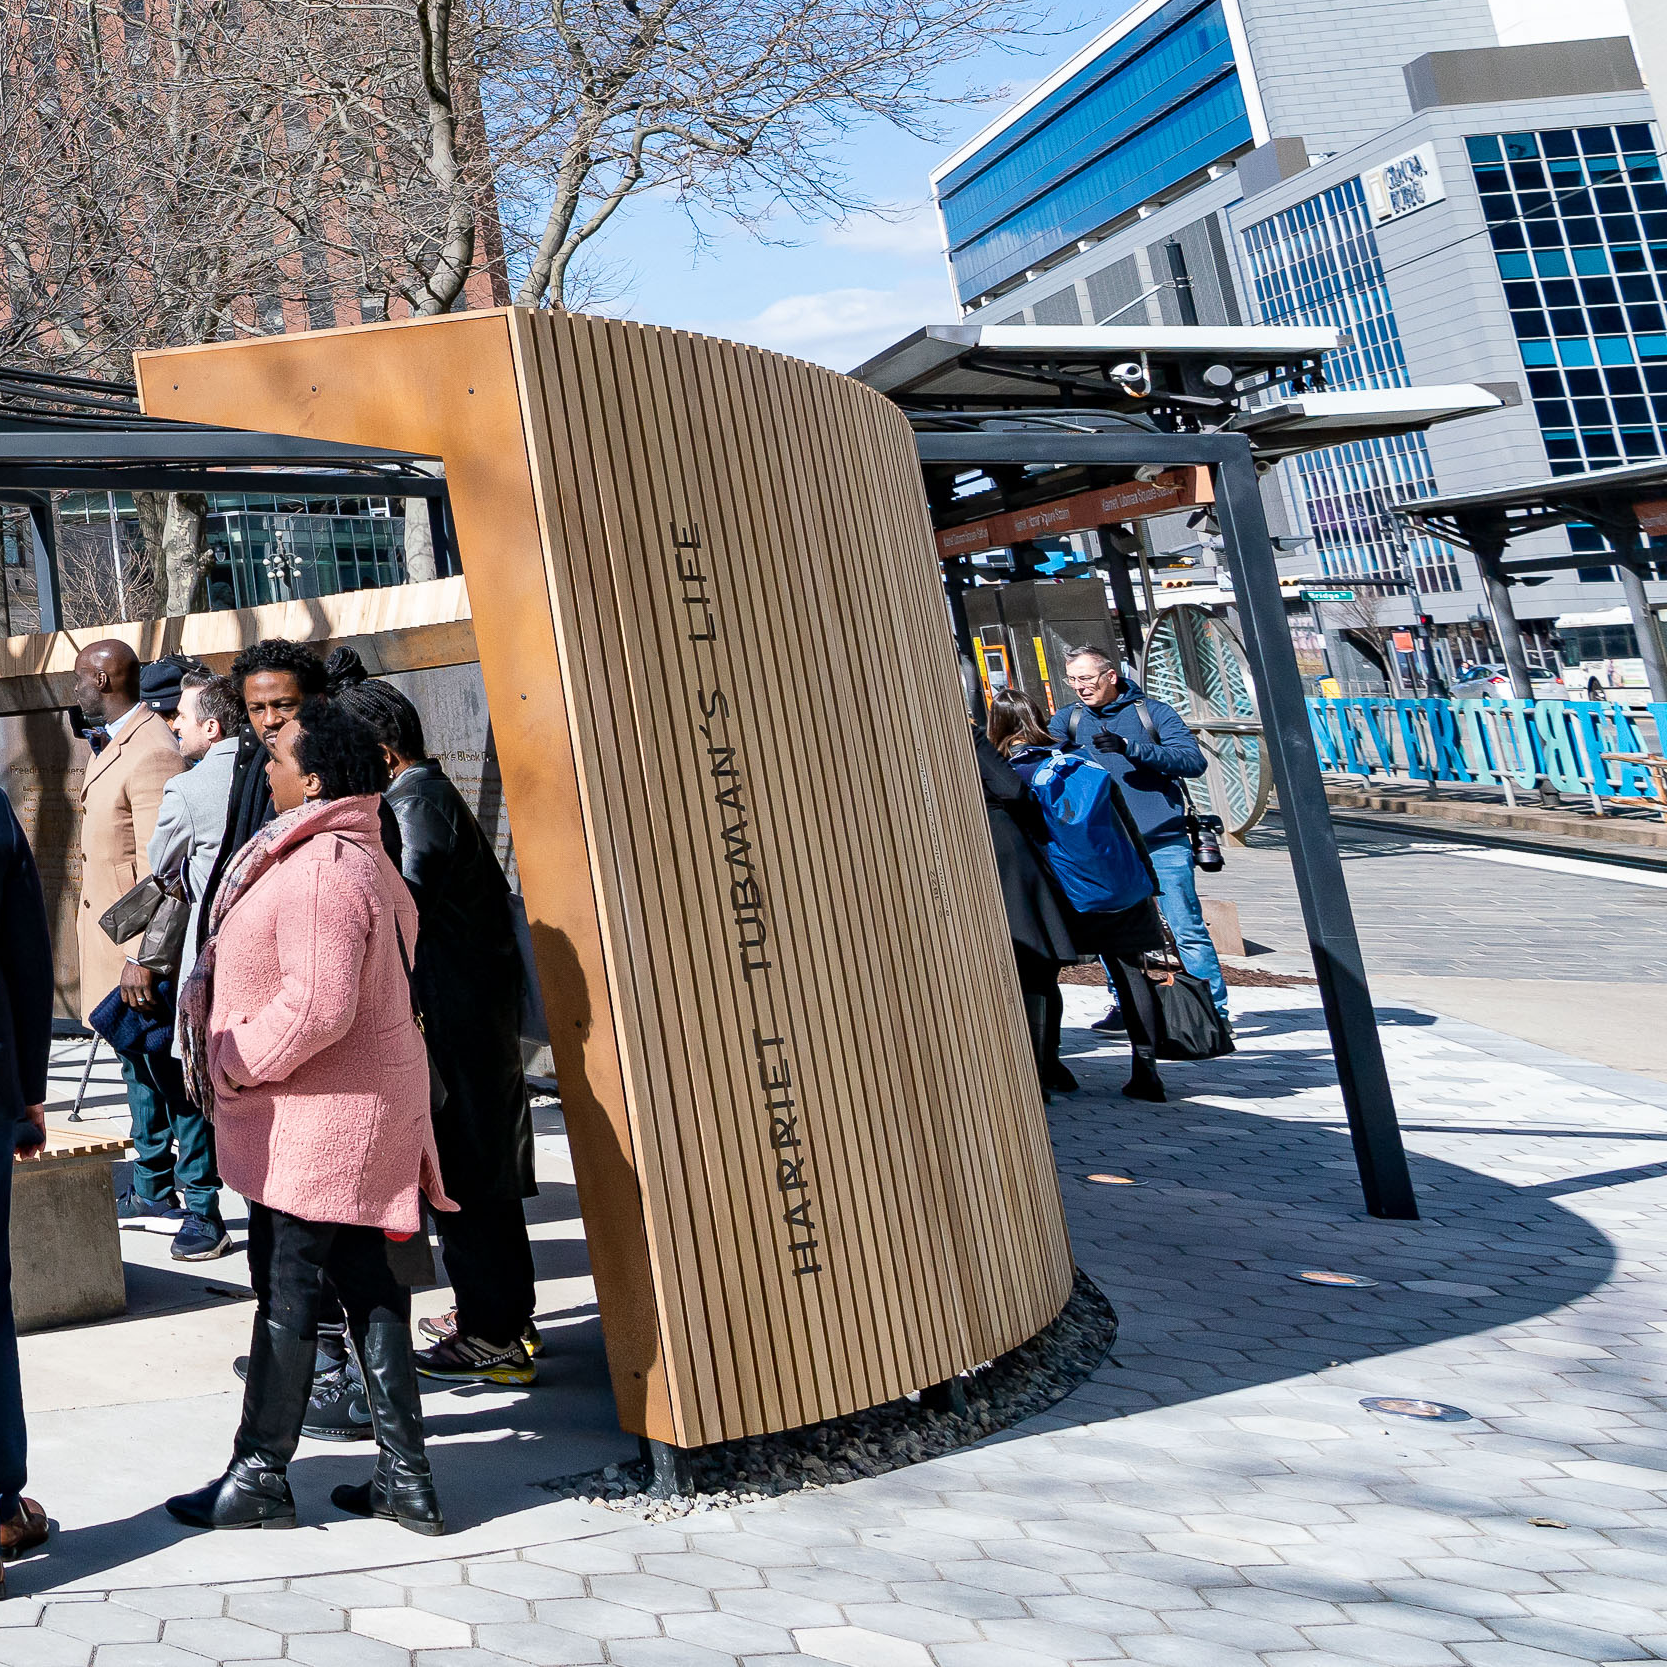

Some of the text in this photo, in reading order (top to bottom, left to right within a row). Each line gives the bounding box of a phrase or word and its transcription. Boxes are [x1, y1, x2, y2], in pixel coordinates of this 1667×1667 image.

[670, 519, 718, 642] LIFE
[1308, 592, 1340, 600] Bridge
[752, 1029, 822, 1276] HARRIET
